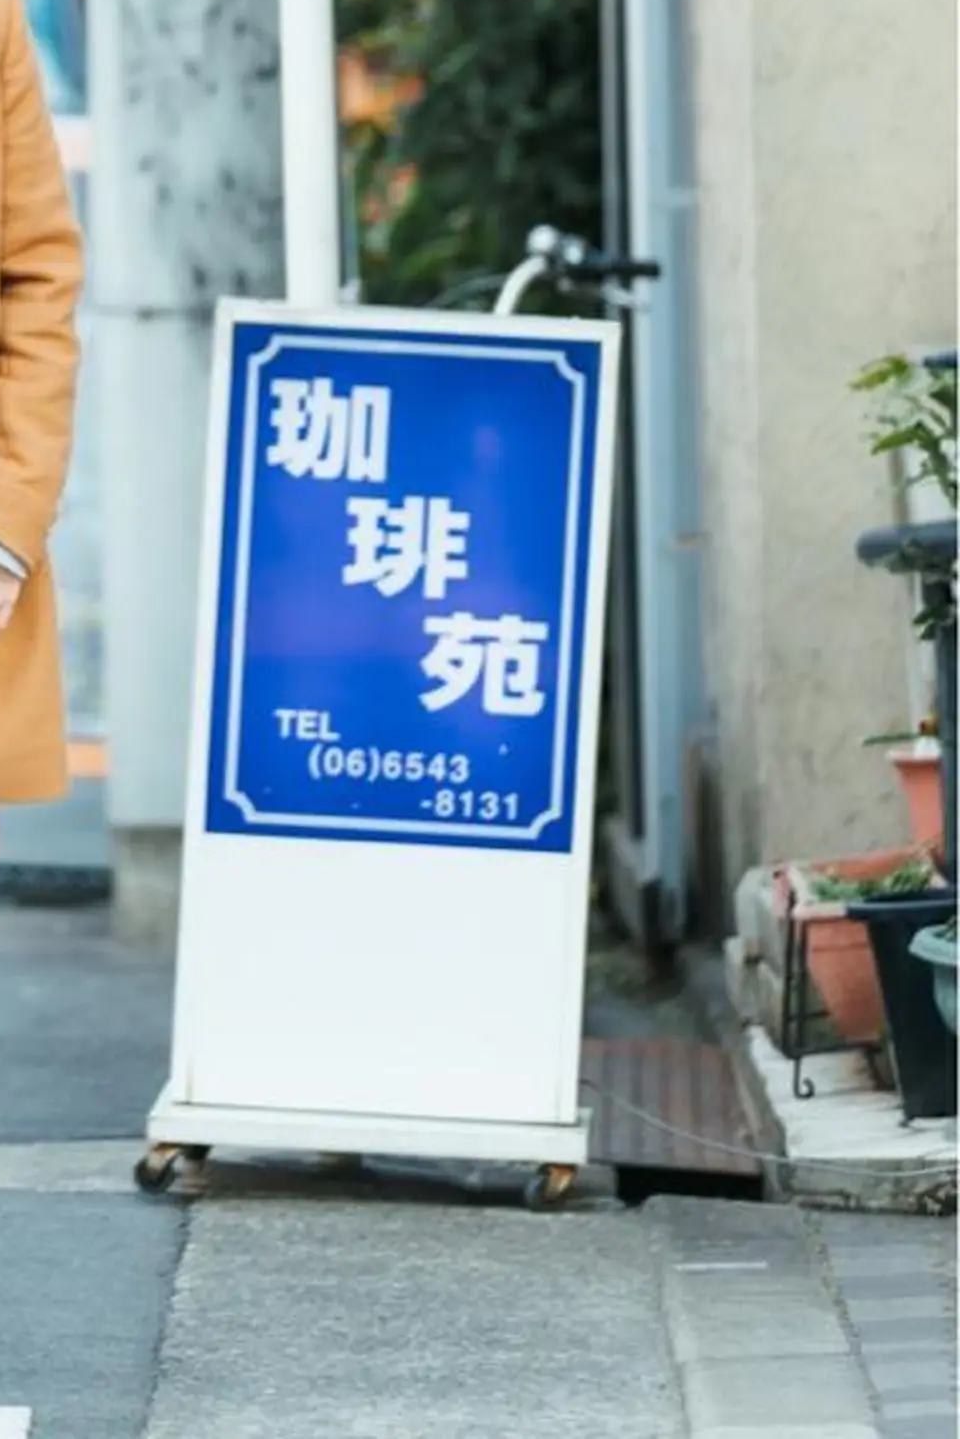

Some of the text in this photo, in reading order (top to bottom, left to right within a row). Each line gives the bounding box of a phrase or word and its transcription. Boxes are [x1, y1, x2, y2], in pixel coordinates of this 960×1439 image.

[274, 707, 341, 742] TEL
[307, 743, 470, 784] (06)6543
[420, 788, 519, 821] -8131
